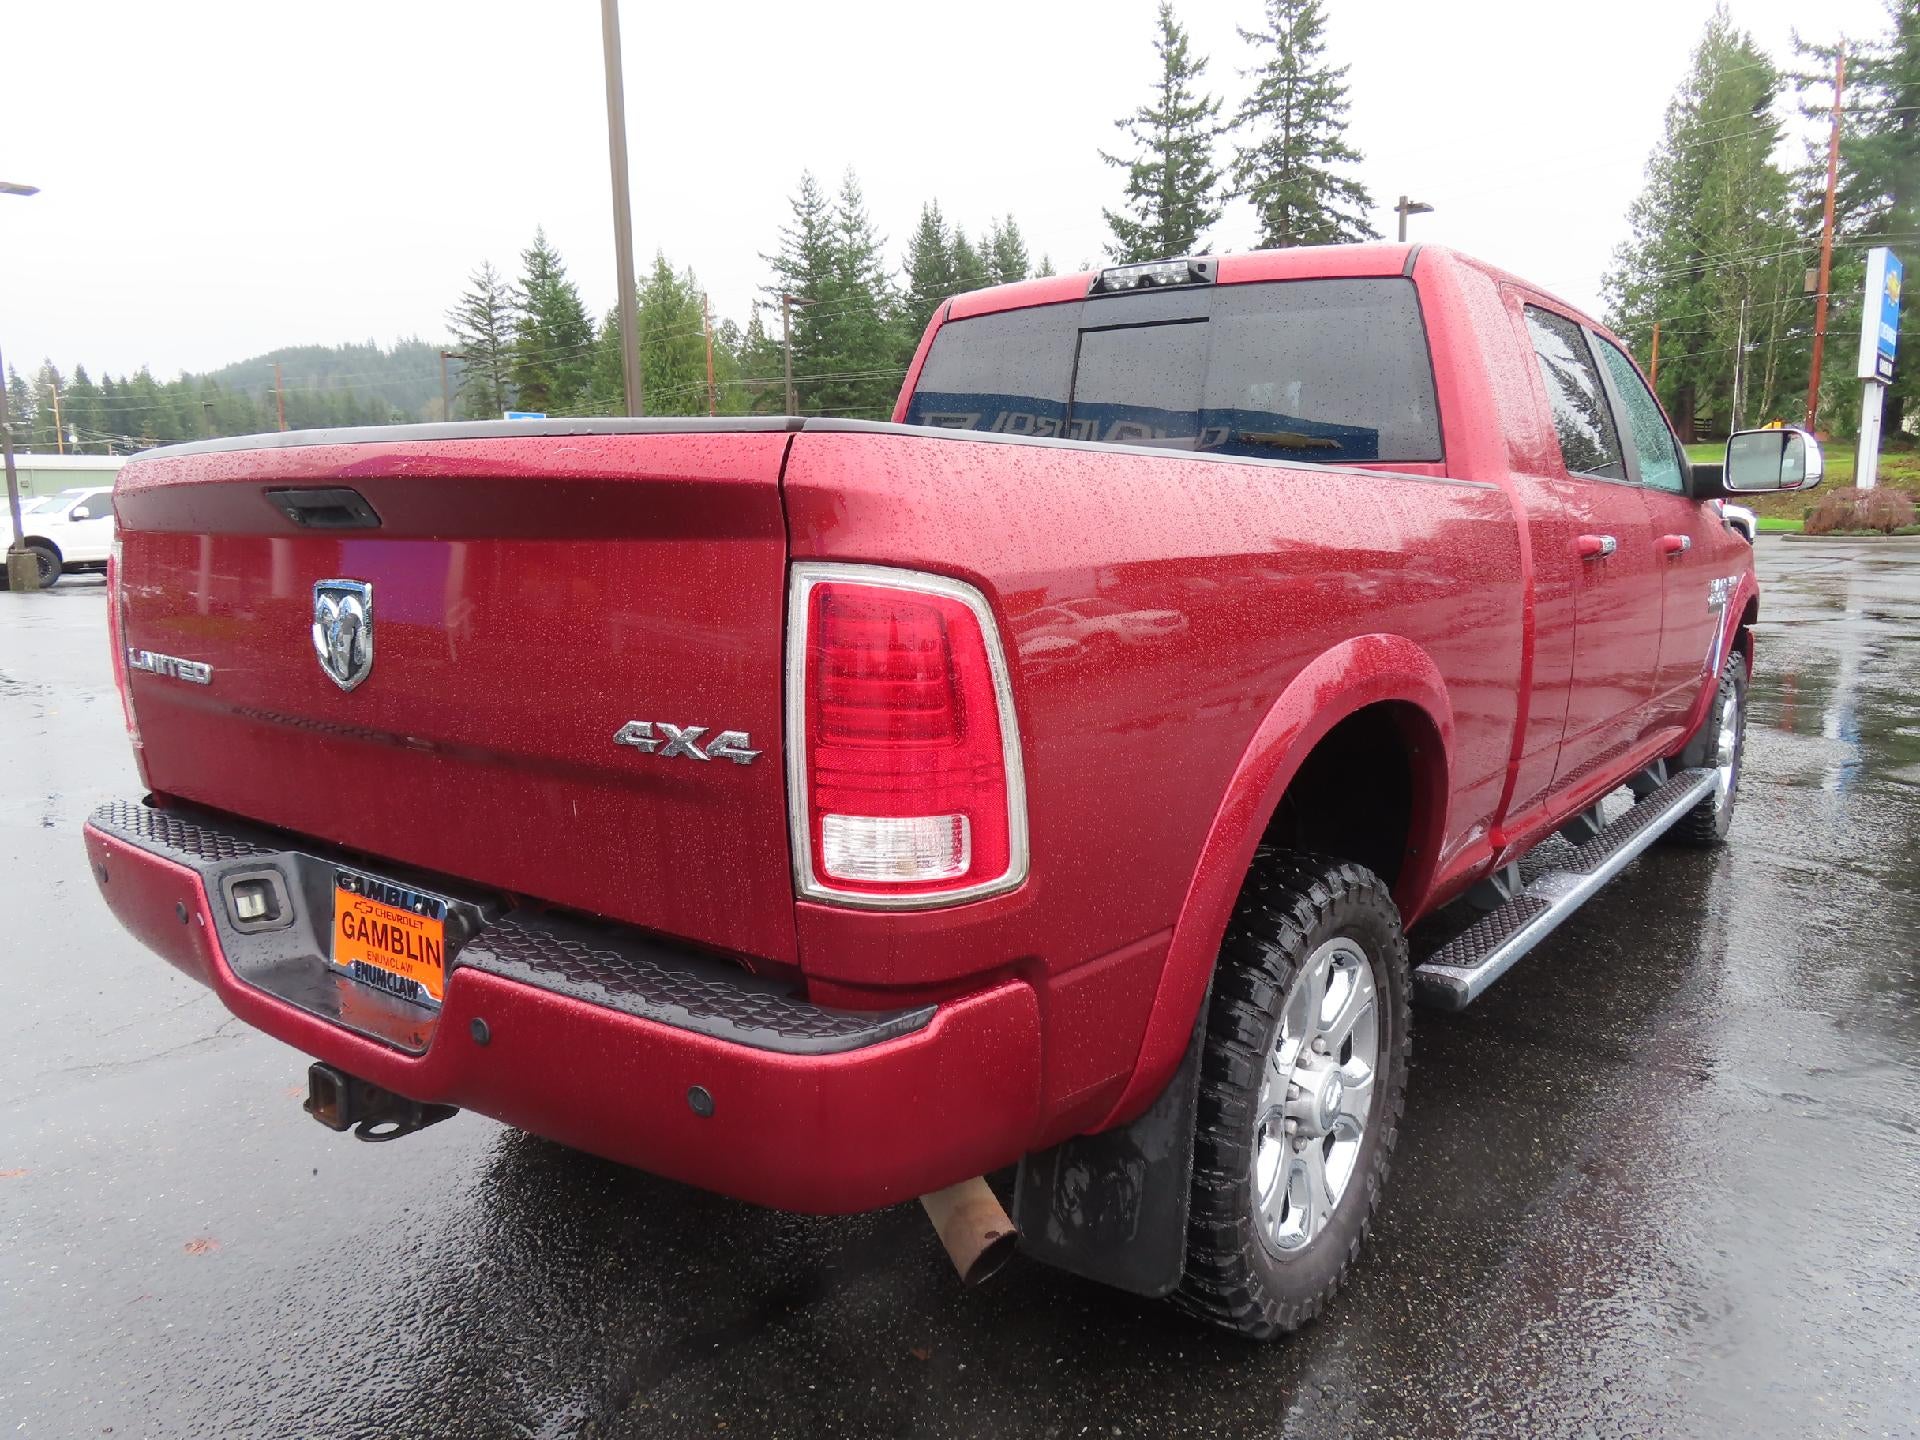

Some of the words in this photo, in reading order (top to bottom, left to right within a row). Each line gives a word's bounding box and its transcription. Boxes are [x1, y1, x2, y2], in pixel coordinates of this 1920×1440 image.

[128, 648, 211, 684] LIMITED
[375, 908, 424, 931] CHEVROLET
[342, 911, 441, 968] GAMBLIN
[355, 960, 419, 999] ENUMCLAW
[367, 951, 413, 973] ENUMCLAW
